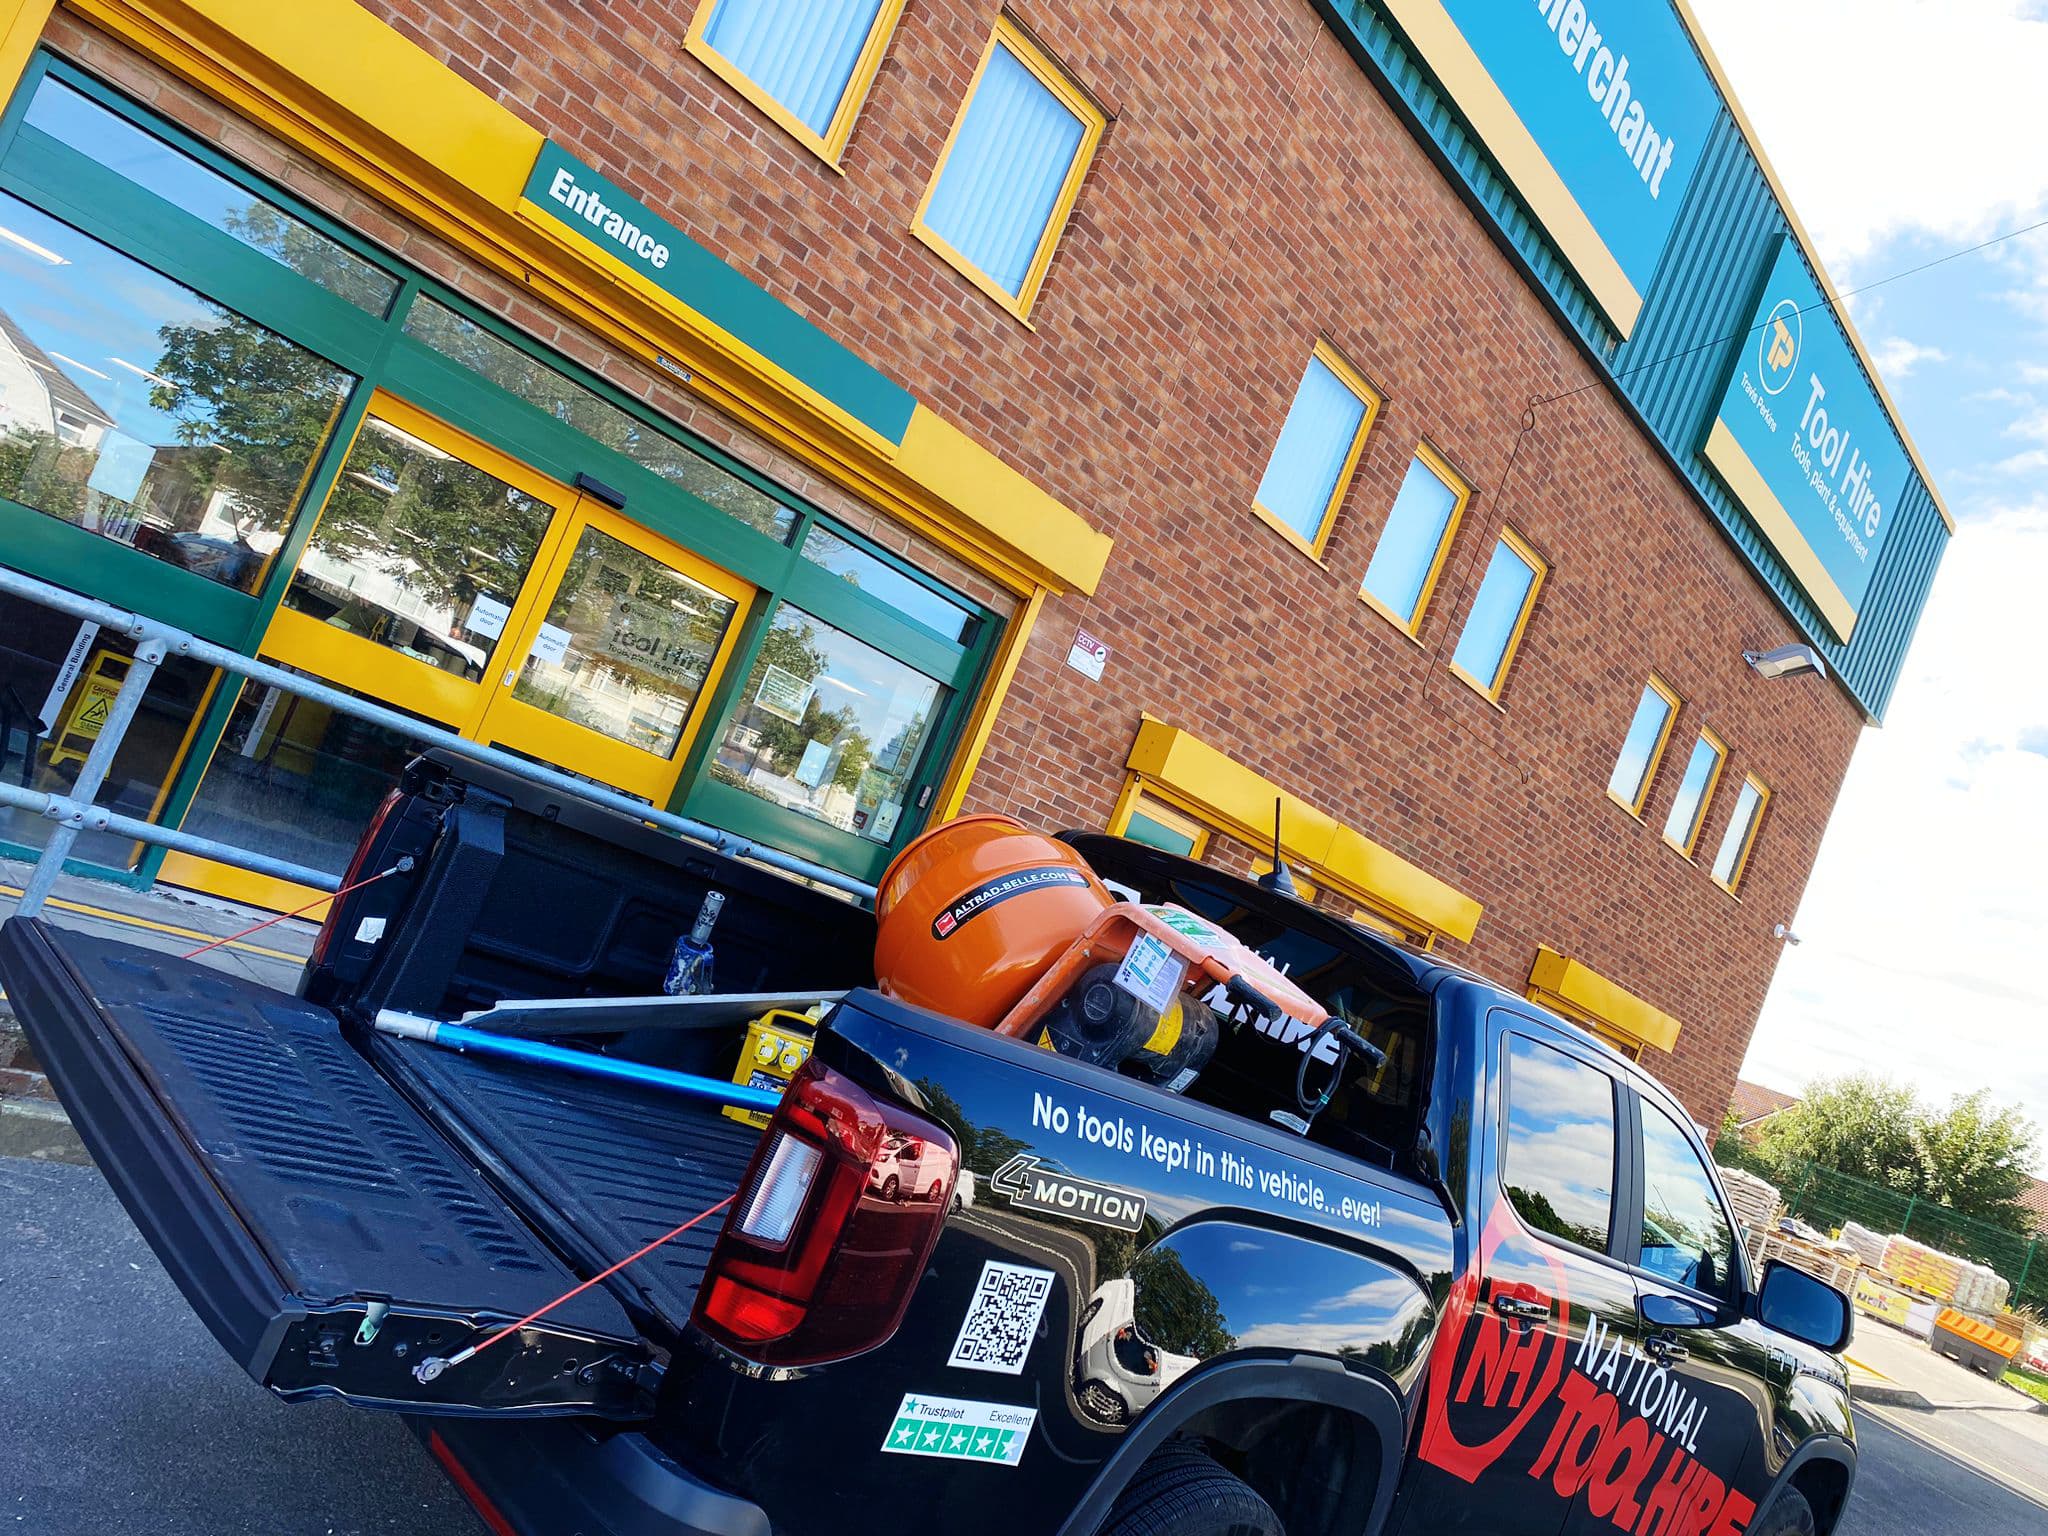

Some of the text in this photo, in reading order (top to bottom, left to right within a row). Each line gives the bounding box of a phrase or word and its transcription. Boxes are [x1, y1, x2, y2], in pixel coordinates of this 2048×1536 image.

[549, 167, 670, 269] Entrance
[1740, 372, 1778, 433] Travis Perkins
[1800, 372, 1882, 538] Tool Hire
[1790, 432, 1869, 563] Tools, plant & equipment
[475, 606, 504, 623] Automatic
[480, 616, 495, 626] door
[539, 632, 567, 649] Automatic
[57, 633, 91, 693] General Building
[543, 642, 557, 652] door
[1078, 635, 1095, 649] CCTV
[955, 872, 1068, 919] ALTRAD-BELLE.COM
[1032, 1092, 1382, 1229] No tools kept in this vehicle...ever!
[1575, 1312, 1708, 1454] NATIONAL
[919, 1403, 1032, 1426] Trustpilot Excellent
